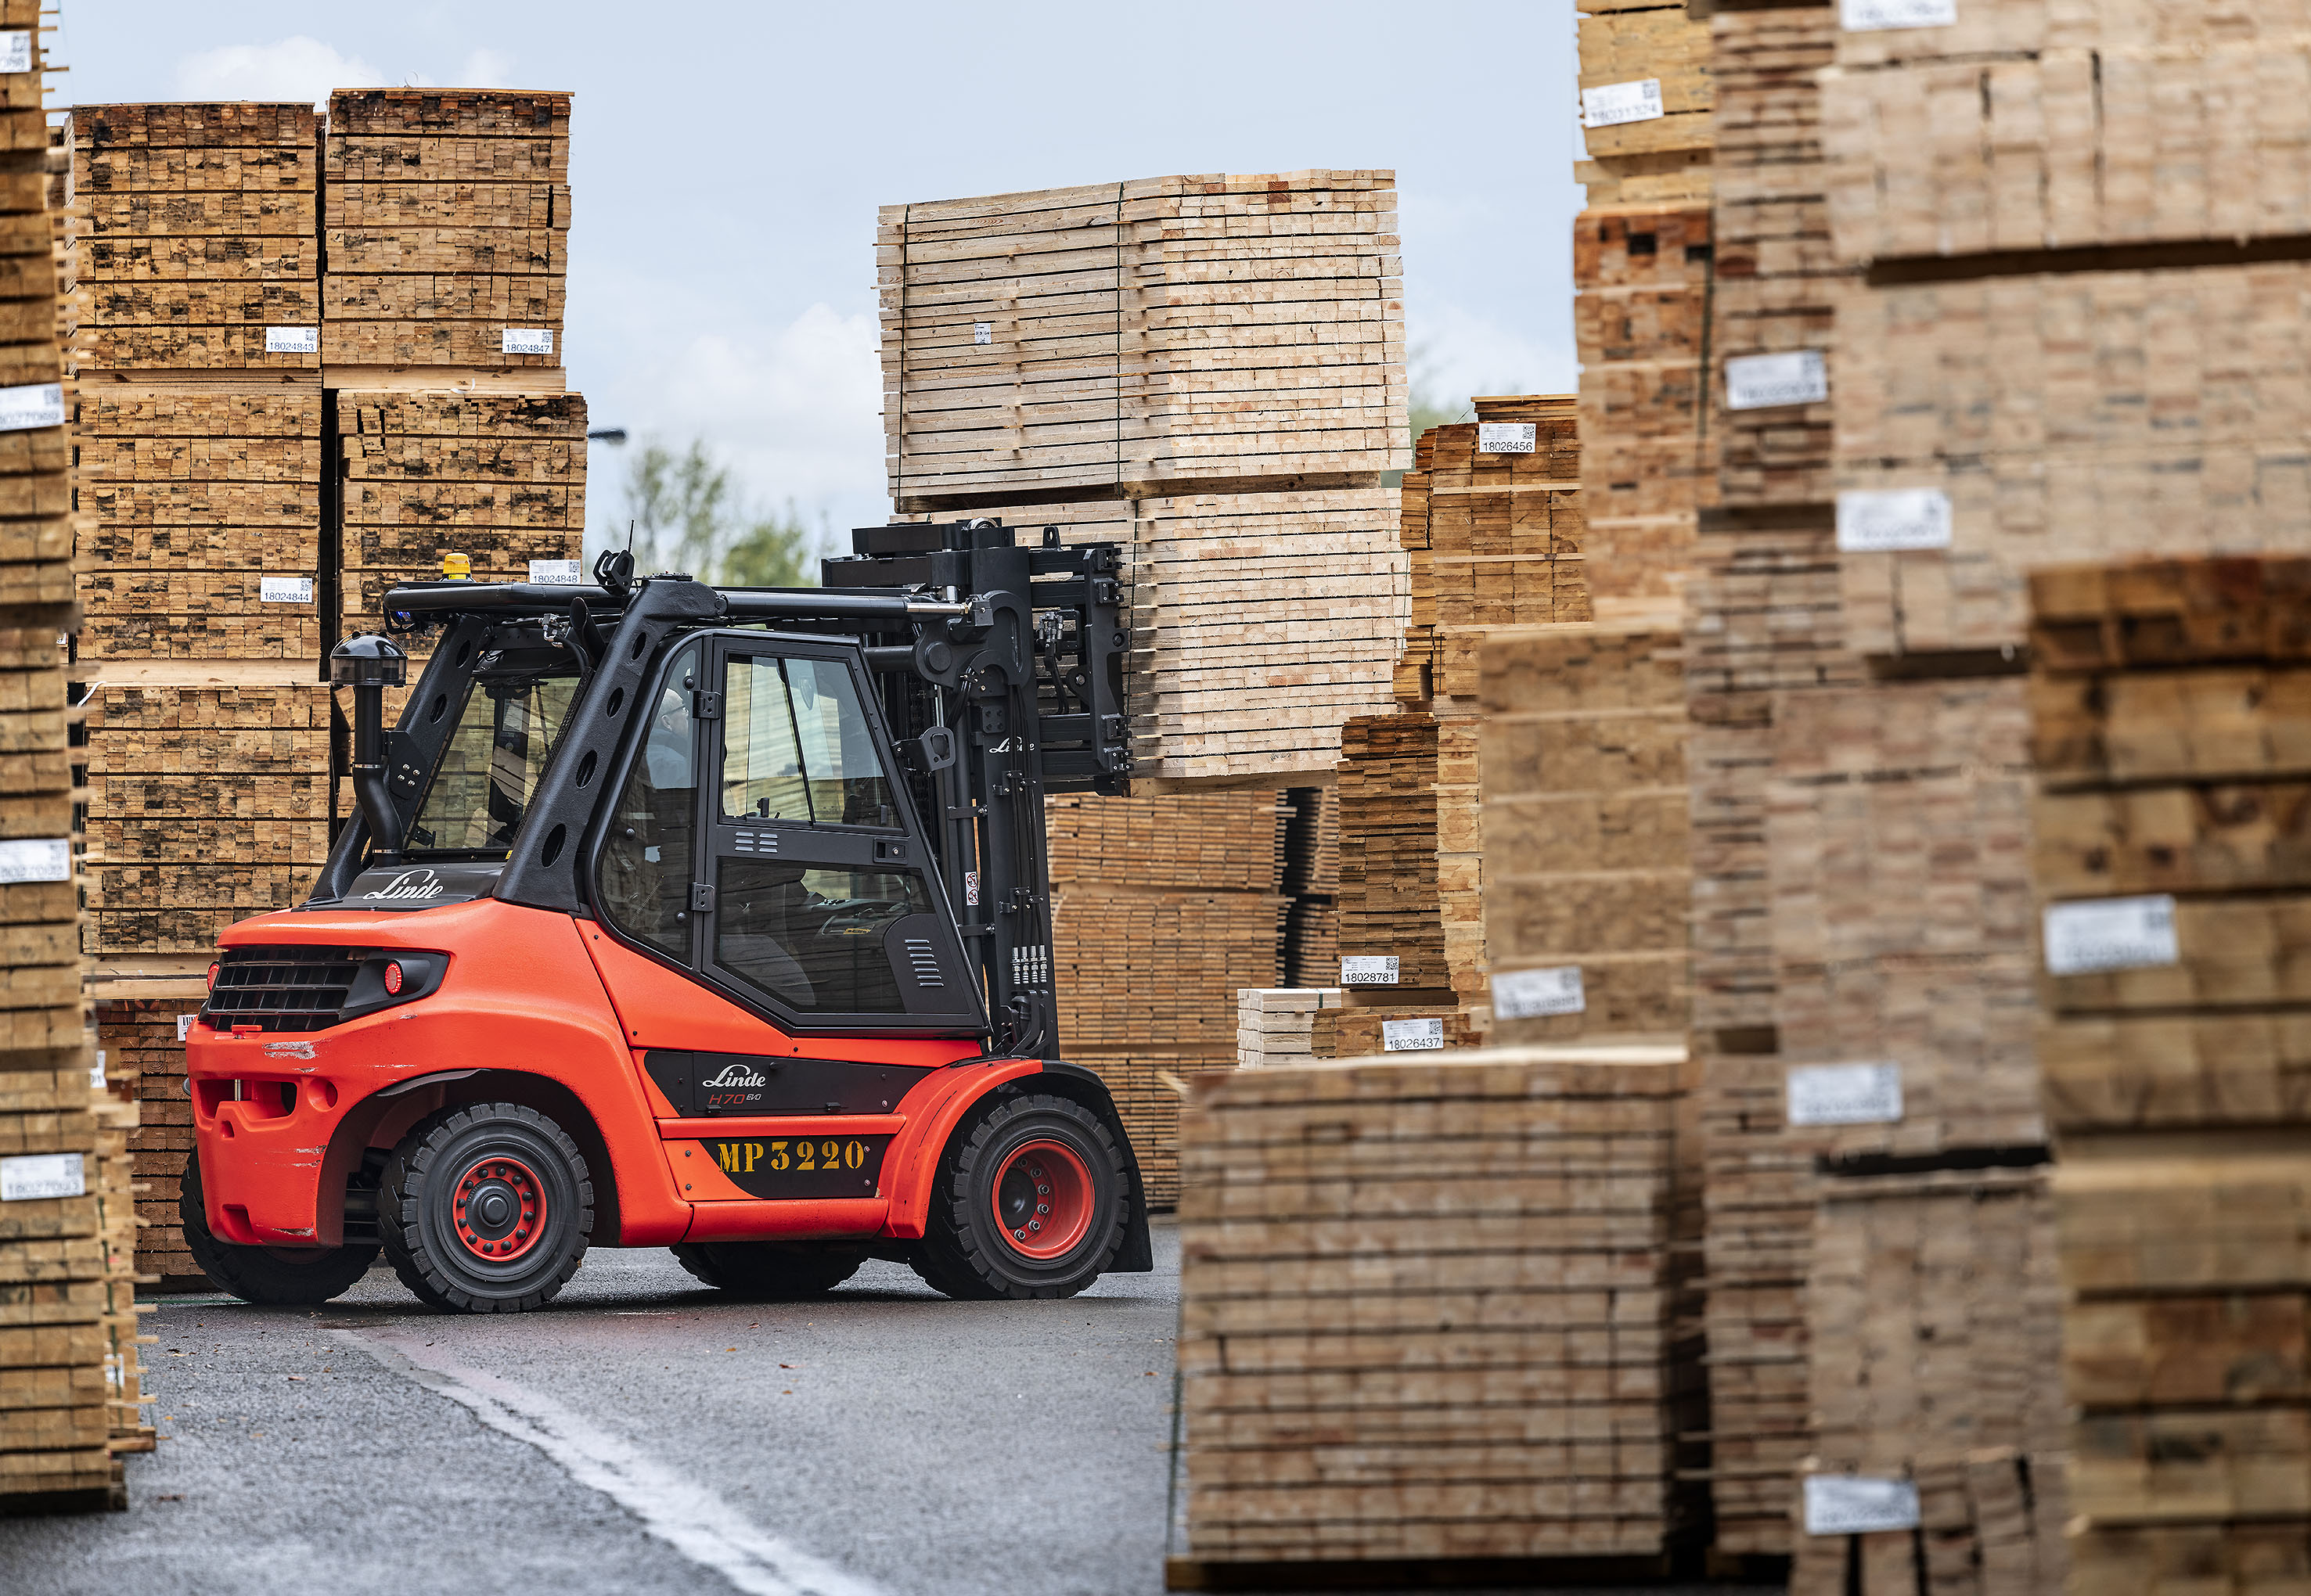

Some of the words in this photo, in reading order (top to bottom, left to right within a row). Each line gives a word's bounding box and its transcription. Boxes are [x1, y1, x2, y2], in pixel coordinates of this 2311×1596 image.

[270, 342, 314, 351] 18024843
[1483, 441, 1532, 451] 18026456
[265, 592, 308, 601] 18024844
[362, 869, 444, 899] Linde
[1345, 972, 1395, 982] 18028781
[1389, 1037, 1440, 1049] 18026437
[703, 1064, 766, 1087] Linde
[709, 1094, 746, 1104] H70
